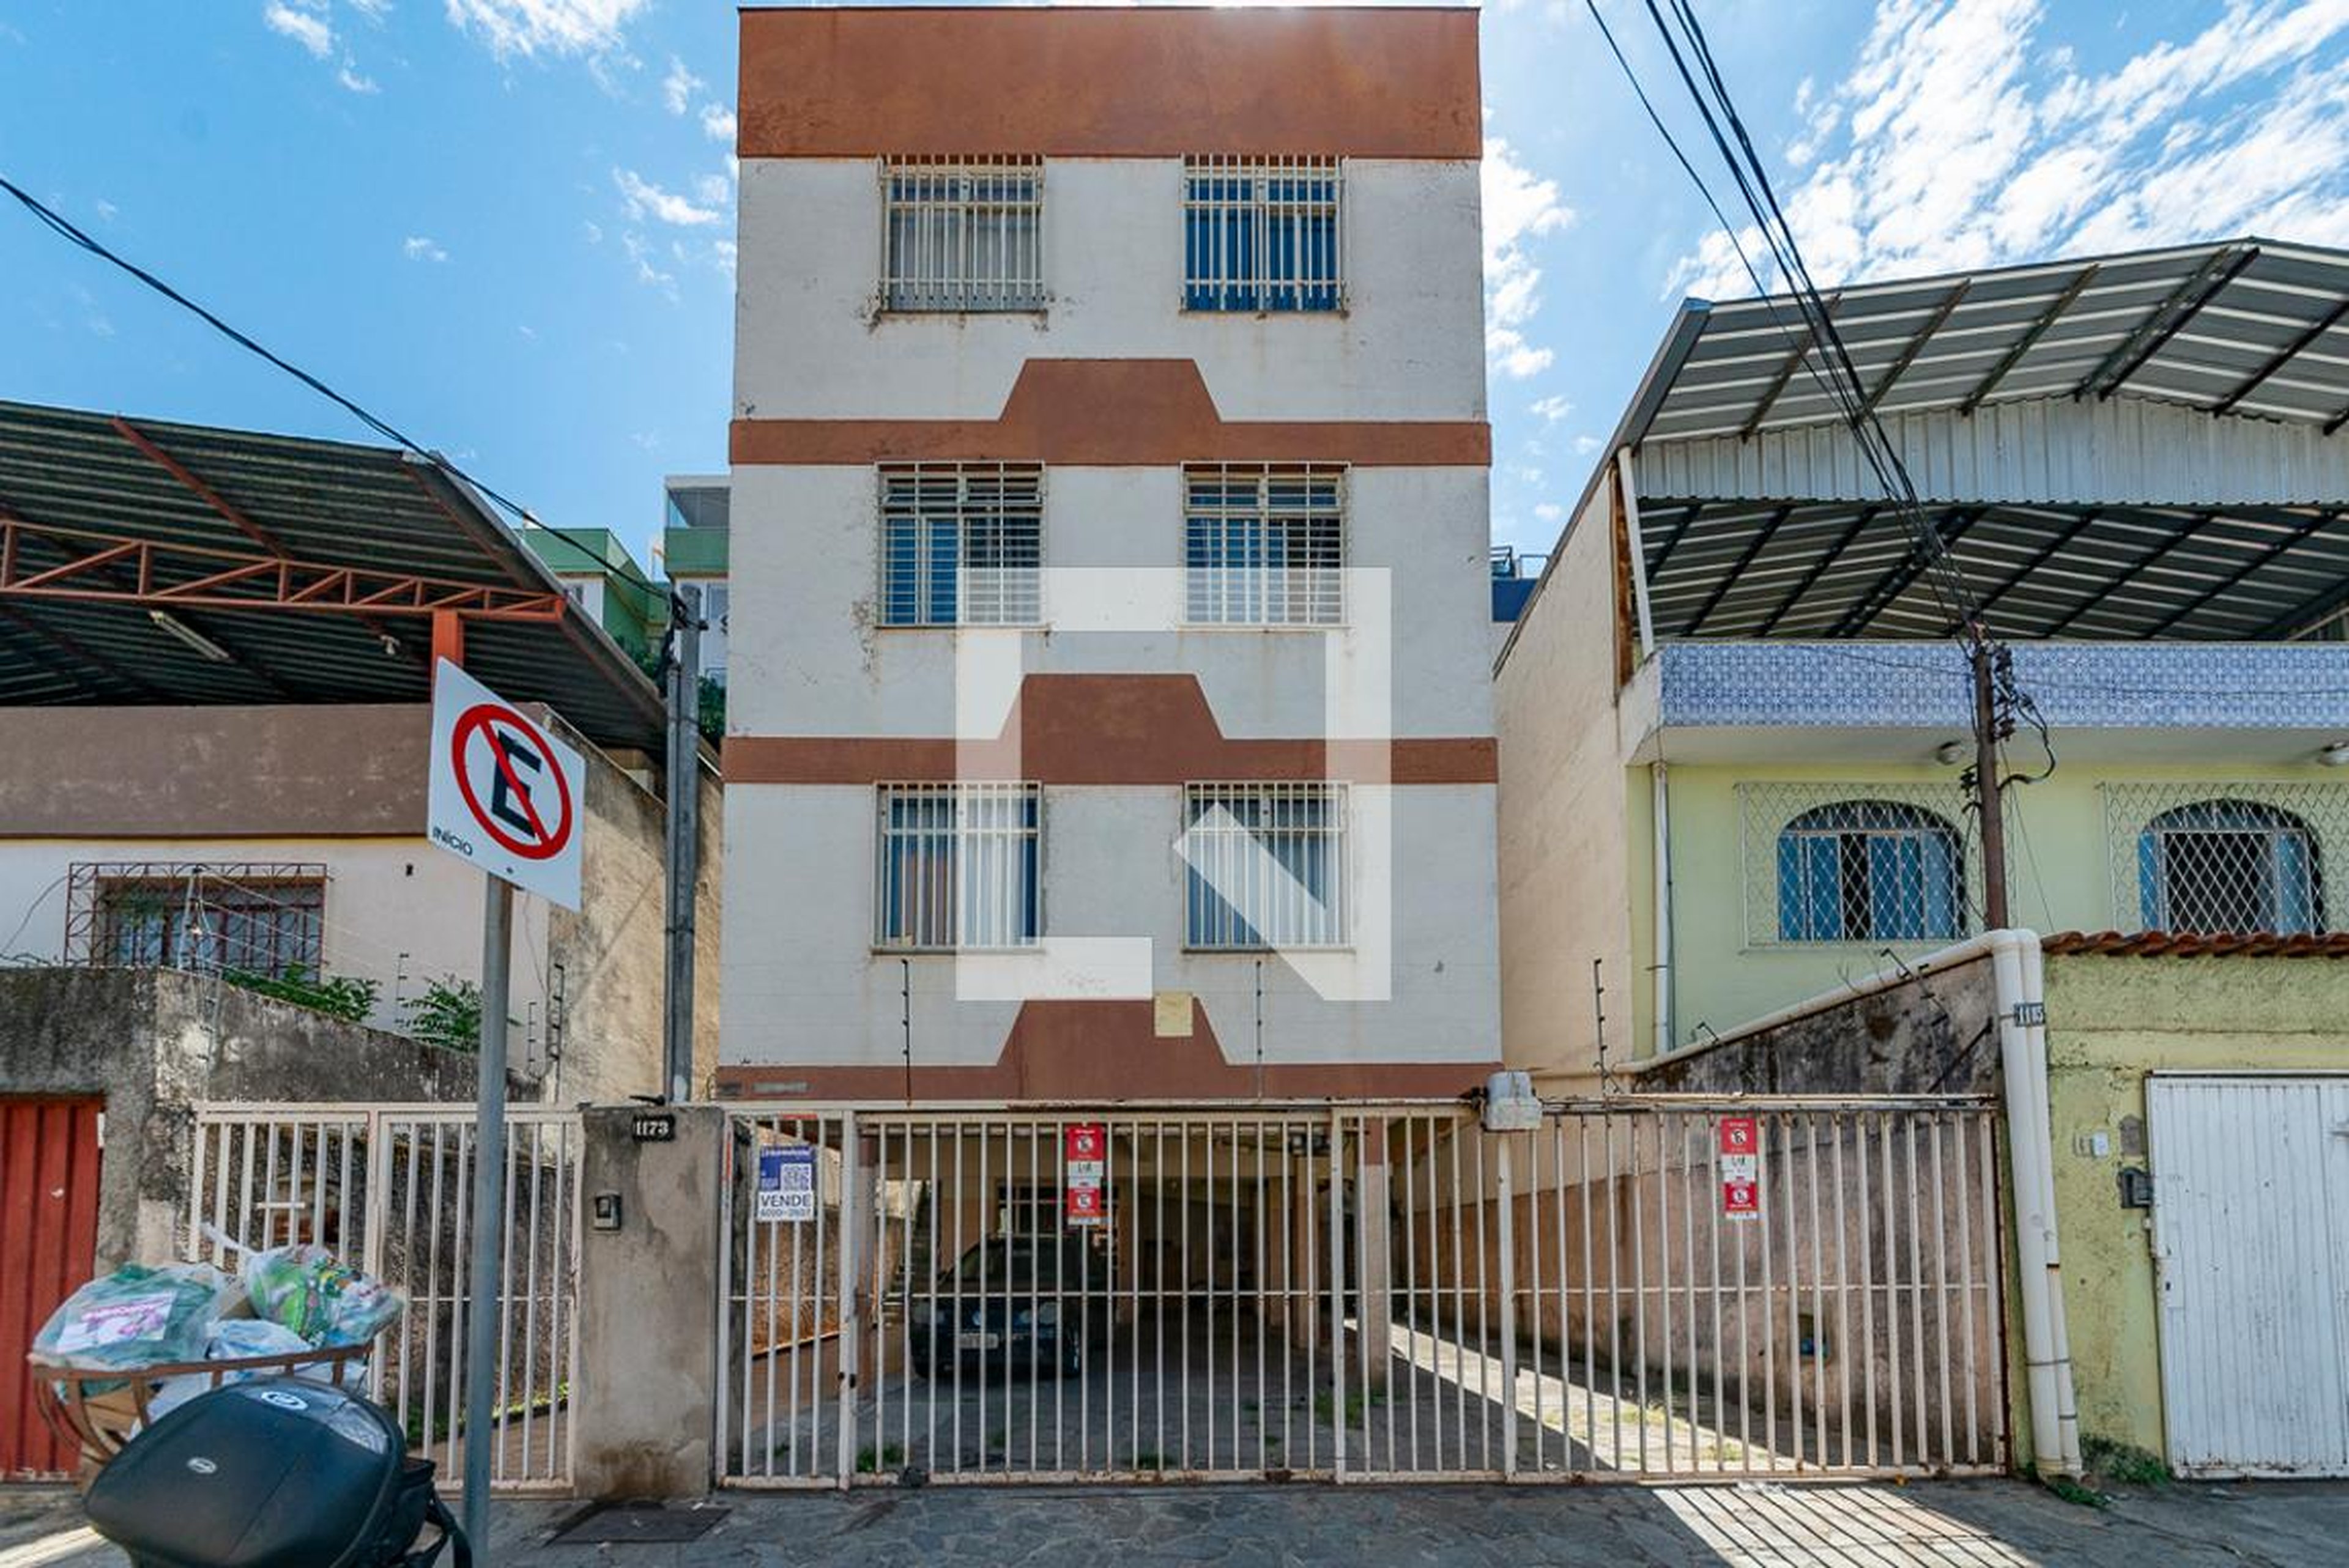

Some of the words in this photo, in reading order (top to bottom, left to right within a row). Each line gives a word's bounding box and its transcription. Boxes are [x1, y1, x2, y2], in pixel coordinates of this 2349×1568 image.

[491, 730, 542, 838] E
[637, 1120, 669, 1136] 1173
[761, 1194, 812, 1208] VENDE
